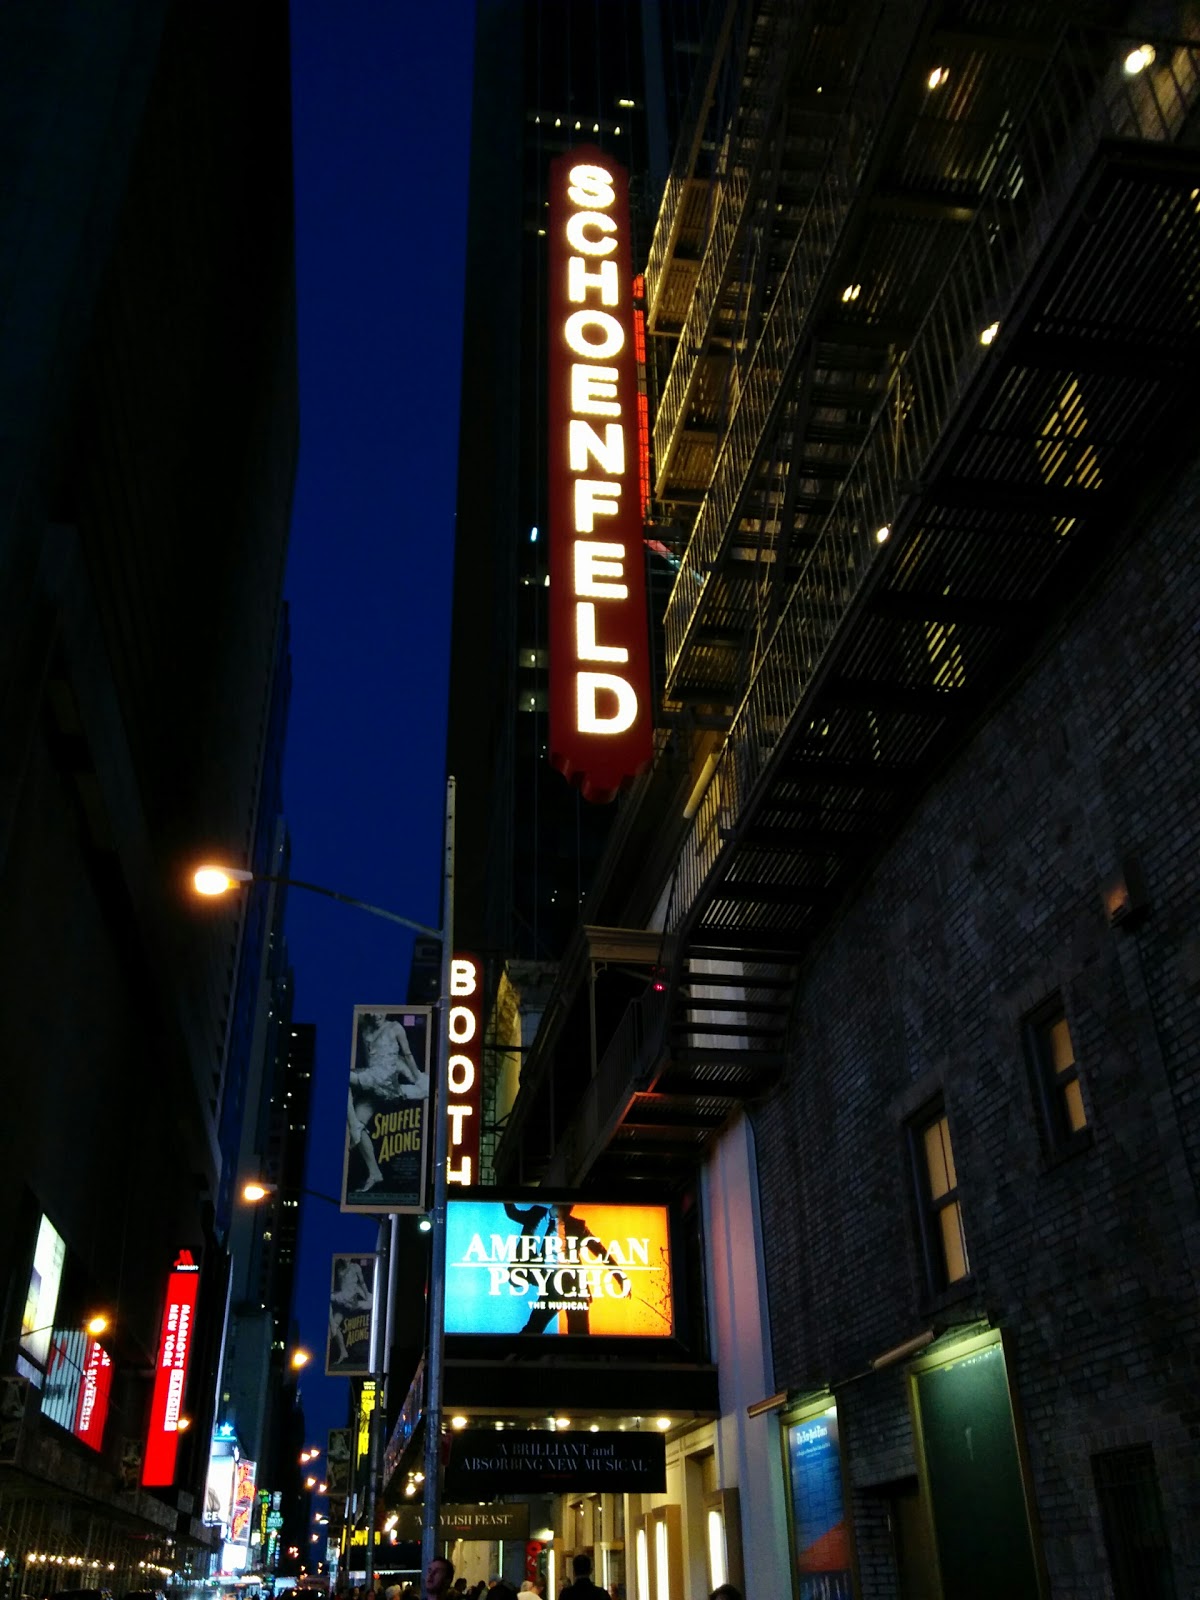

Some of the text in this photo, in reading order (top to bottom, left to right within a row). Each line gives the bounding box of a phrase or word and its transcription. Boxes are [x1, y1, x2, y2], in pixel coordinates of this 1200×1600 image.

[564, 163, 638, 735] SCHOENFELD
[446, 959, 477, 1186] BOOTH
[372, 1107, 422, 1140] SHUFFLE
[378, 1130, 421, 1164] ALONG
[462, 1232, 650, 1265] AMERICAN
[488, 1267, 632, 1299] PSYCHO
[527, 1300, 589, 1311] THE MUSICAL
[163, 1304, 179, 1367] NEW YORK
[174, 1304, 190, 1368] MARRIOTT
[342, 1313, 370, 1334] SHUFFLE
[345, 1327, 369, 1347] ALONG
[463, 1457, 543, 1471] ABSORBING
[547, 1458, 580, 1471] NEW
[512, 1443, 589, 1456] BRILLIANT
[592, 1444, 614, 1456] and
[438, 1514, 472, 1525] YLISH
